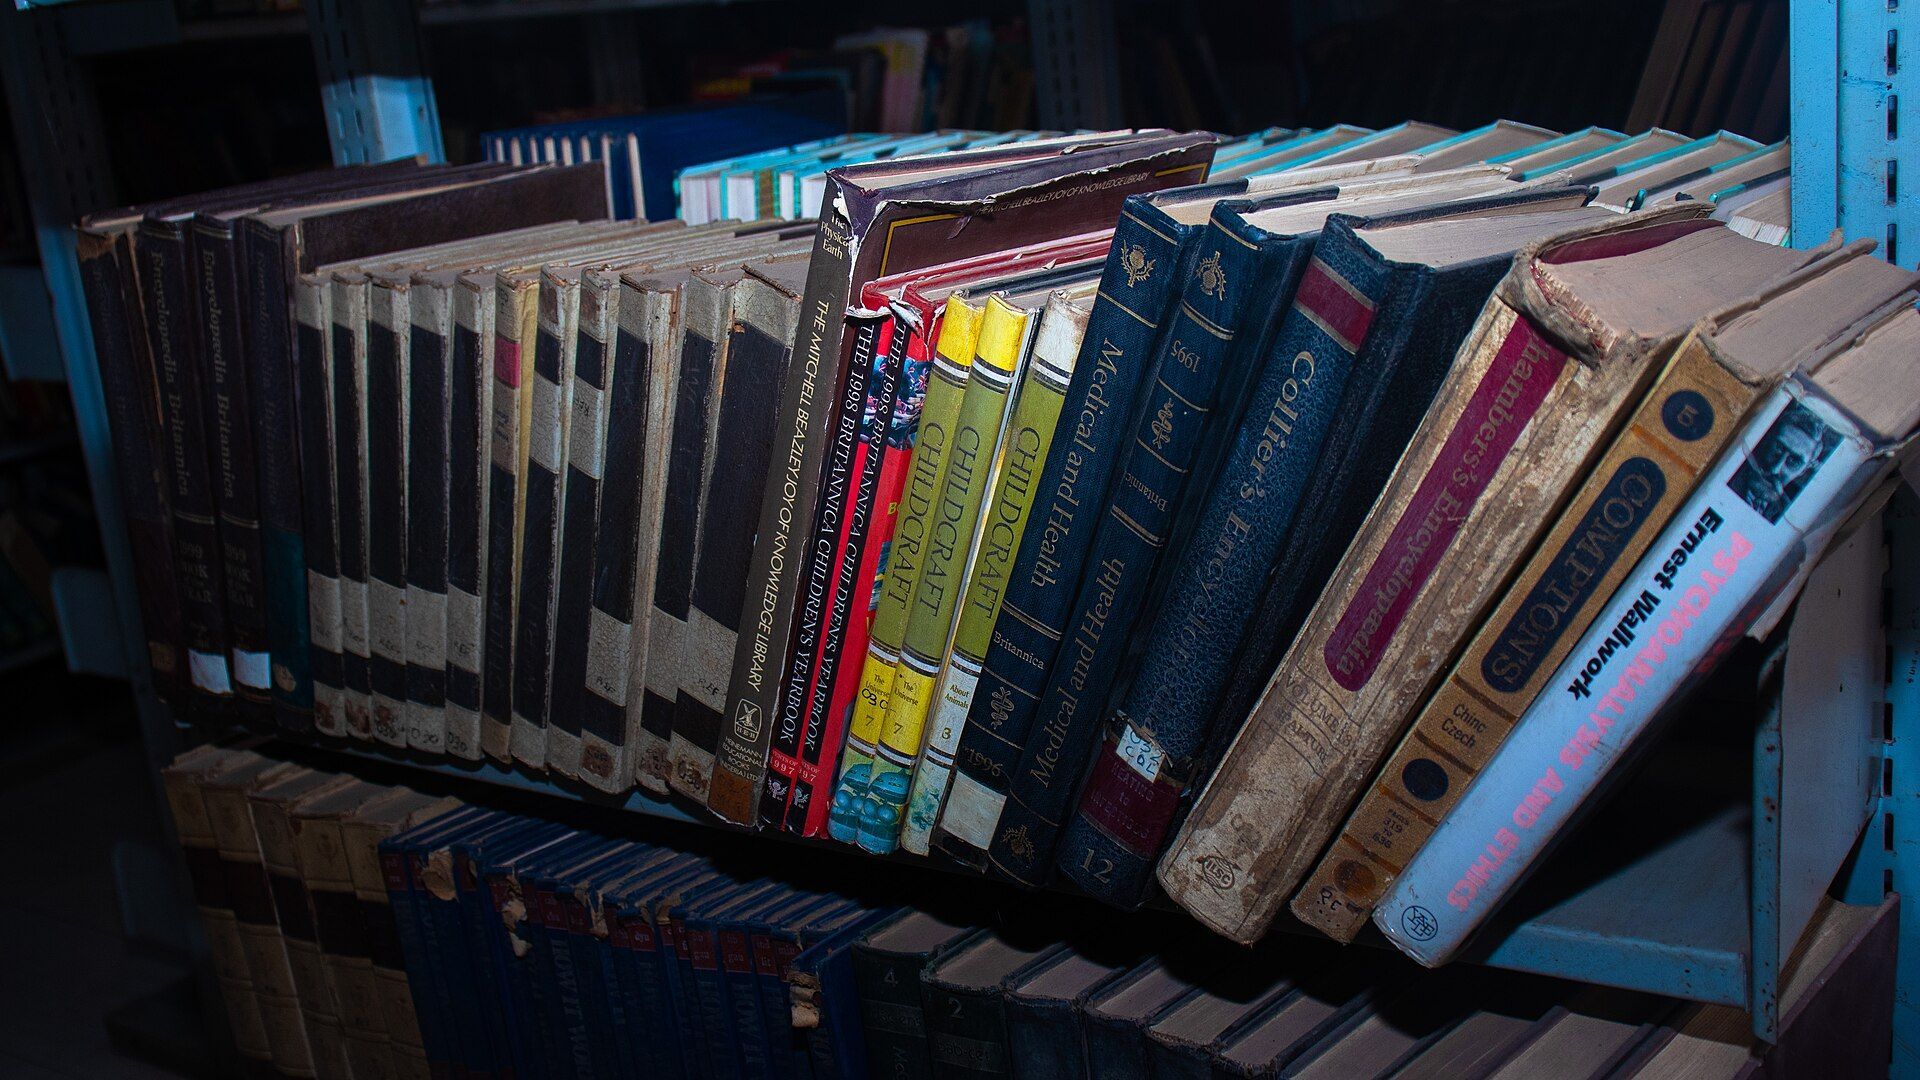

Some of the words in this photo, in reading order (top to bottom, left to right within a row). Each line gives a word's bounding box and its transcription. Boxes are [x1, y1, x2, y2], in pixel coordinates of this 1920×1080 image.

[1053, 189, 1067, 201] JOY
[1067, 187, 1081, 198] OF
[1079, 178, 1124, 194] KNOWLEDGE
[1123, 172, 1150, 185] LIBRARY
[823, 239, 843, 260] Earth
[812, 300, 829, 333] THE
[799, 333, 822, 407] MITCHELL
[855, 324, 875, 367] THE
[886, 323, 907, 368] THE
[1170, 340, 1201, 373] 1995
[845, 371, 864, 413] 1998
[878, 373, 896, 415] 1998
[1075, 337, 1123, 452] Medical
[788, 408, 810, 479] BEAZLEY
[1241, 350, 1316, 500] Collier's
[783, 478, 799, 506] JOY
[821, 413, 856, 533] BRITANNICA
[848, 416, 885, 538] BRITANNICA
[1057, 451, 1083, 507] and
[778, 506, 793, 531] OF
[887, 422, 945, 611] CHILDCRAFT
[919, 425, 980, 617] CHILDCRAFT
[972, 426, 1040, 619] CHILDCRAFT
[1030, 503, 1074, 588] Health
[1654, 506, 1725, 592] Ernest
[759, 531, 788, 634] KNOWLEDGE
[799, 537, 832, 651] CHILDREN'S
[824, 541, 858, 653] CHILDREN'S
[1080, 557, 1126, 646] Health
[1498, 470, 1654, 687] COMPTON'S
[748, 632, 769, 692] LIBRARY
[994, 631, 1046, 669] Britannica
[1069, 637, 1096, 692] and
[1558, 530, 1755, 773] PSYCHOANALYSIS
[1566, 588, 1662, 703] Wallwork
[780, 650, 807, 744] YEARBOOK
[803, 654, 834, 751] YEARBOOK
[865, 680, 890, 698] Universe
[874, 673, 885, 686] The
[894, 687, 919, 706] Universe
[903, 680, 914, 693] The
[944, 693, 969, 710] Animals
[949, 684, 970, 698] About
[1286, 673, 1340, 734] VOLUME
[724, 736, 763, 759] HEINEMANN
[865, 714, 875, 727] 7
[893, 722, 904, 735] 7
[941, 727, 952, 740] 3
[1030, 685, 1079, 790] Medical
[1441, 717, 1477, 748] Czech
[721, 742, 764, 768] EDUCATIONAL
[770, 756, 795, 775] 1997
[1511, 767, 1567, 831] AND
[1080, 847, 1114, 885] 12
[1446, 827, 1521, 914] ETHICS
[948, 997, 965, 1020] 2
